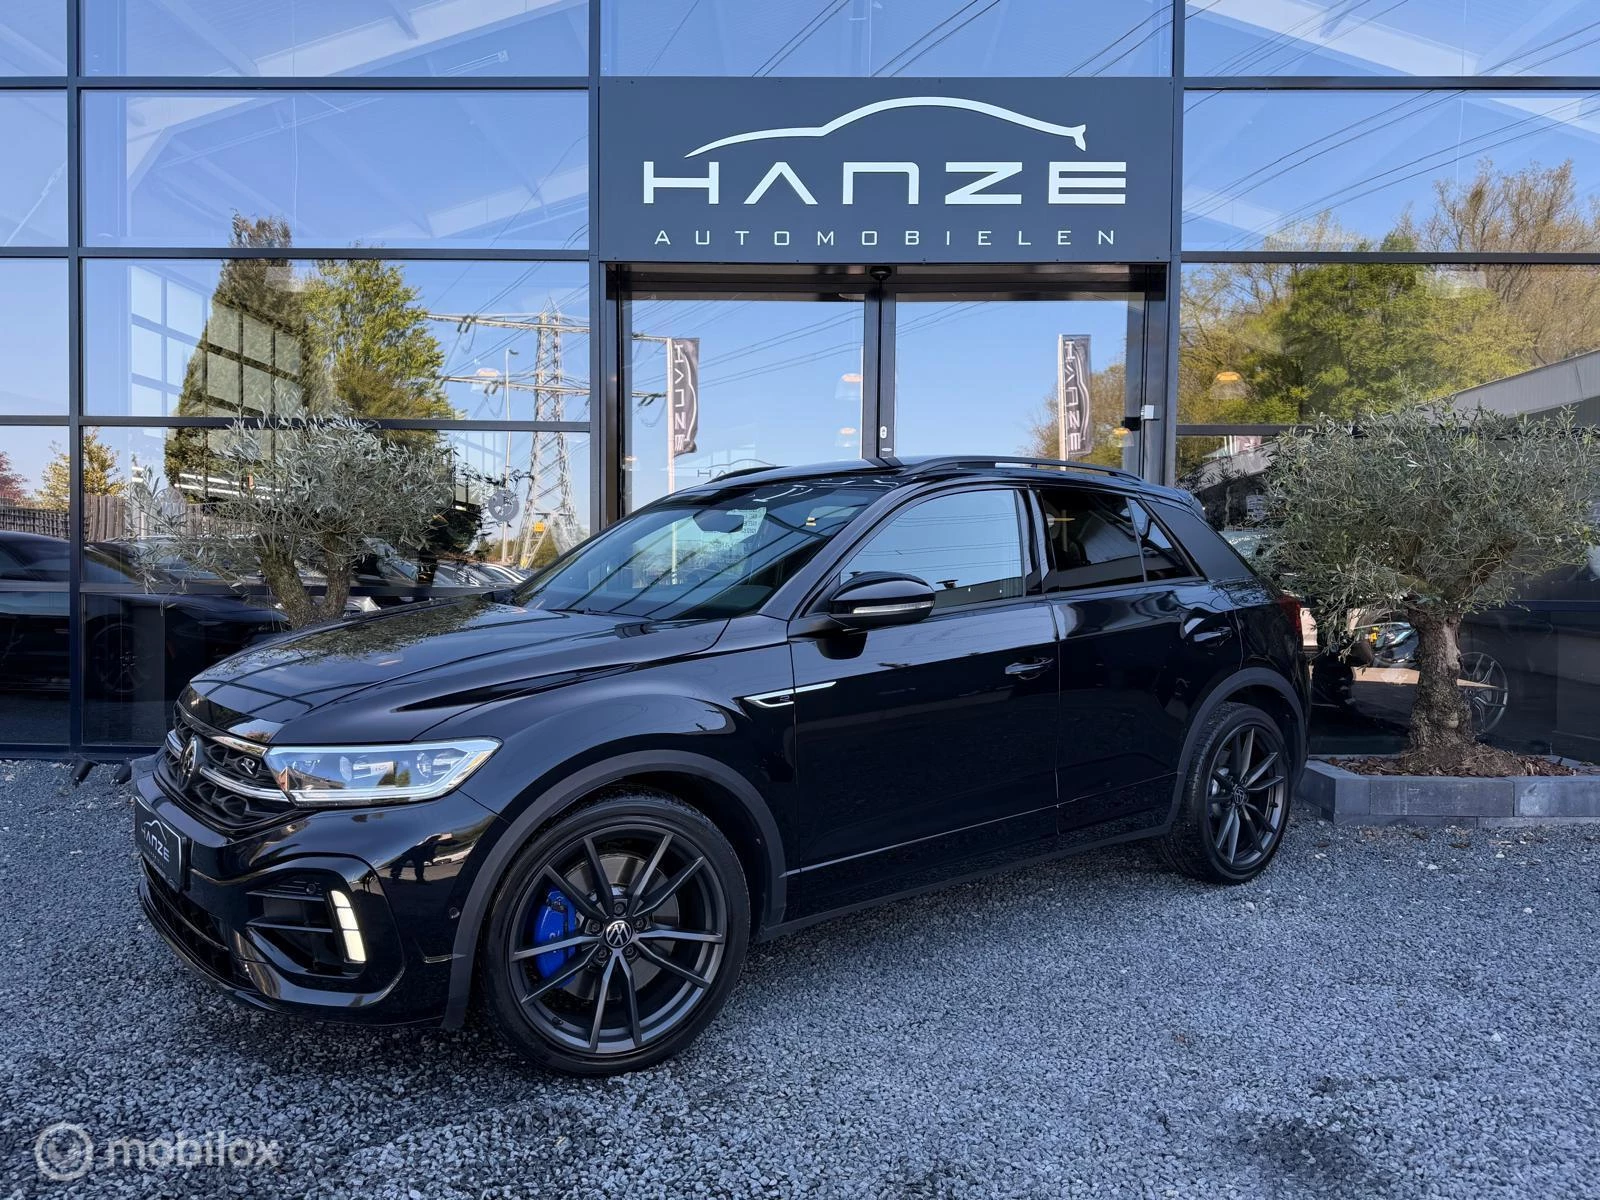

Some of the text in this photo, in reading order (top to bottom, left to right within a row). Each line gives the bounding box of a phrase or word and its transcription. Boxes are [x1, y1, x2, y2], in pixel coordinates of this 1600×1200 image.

[643, 161, 1127, 205] HANZE
[654, 230, 1115, 246] AUTOMOBIELEN
[674, 344, 686, 451] HANZE
